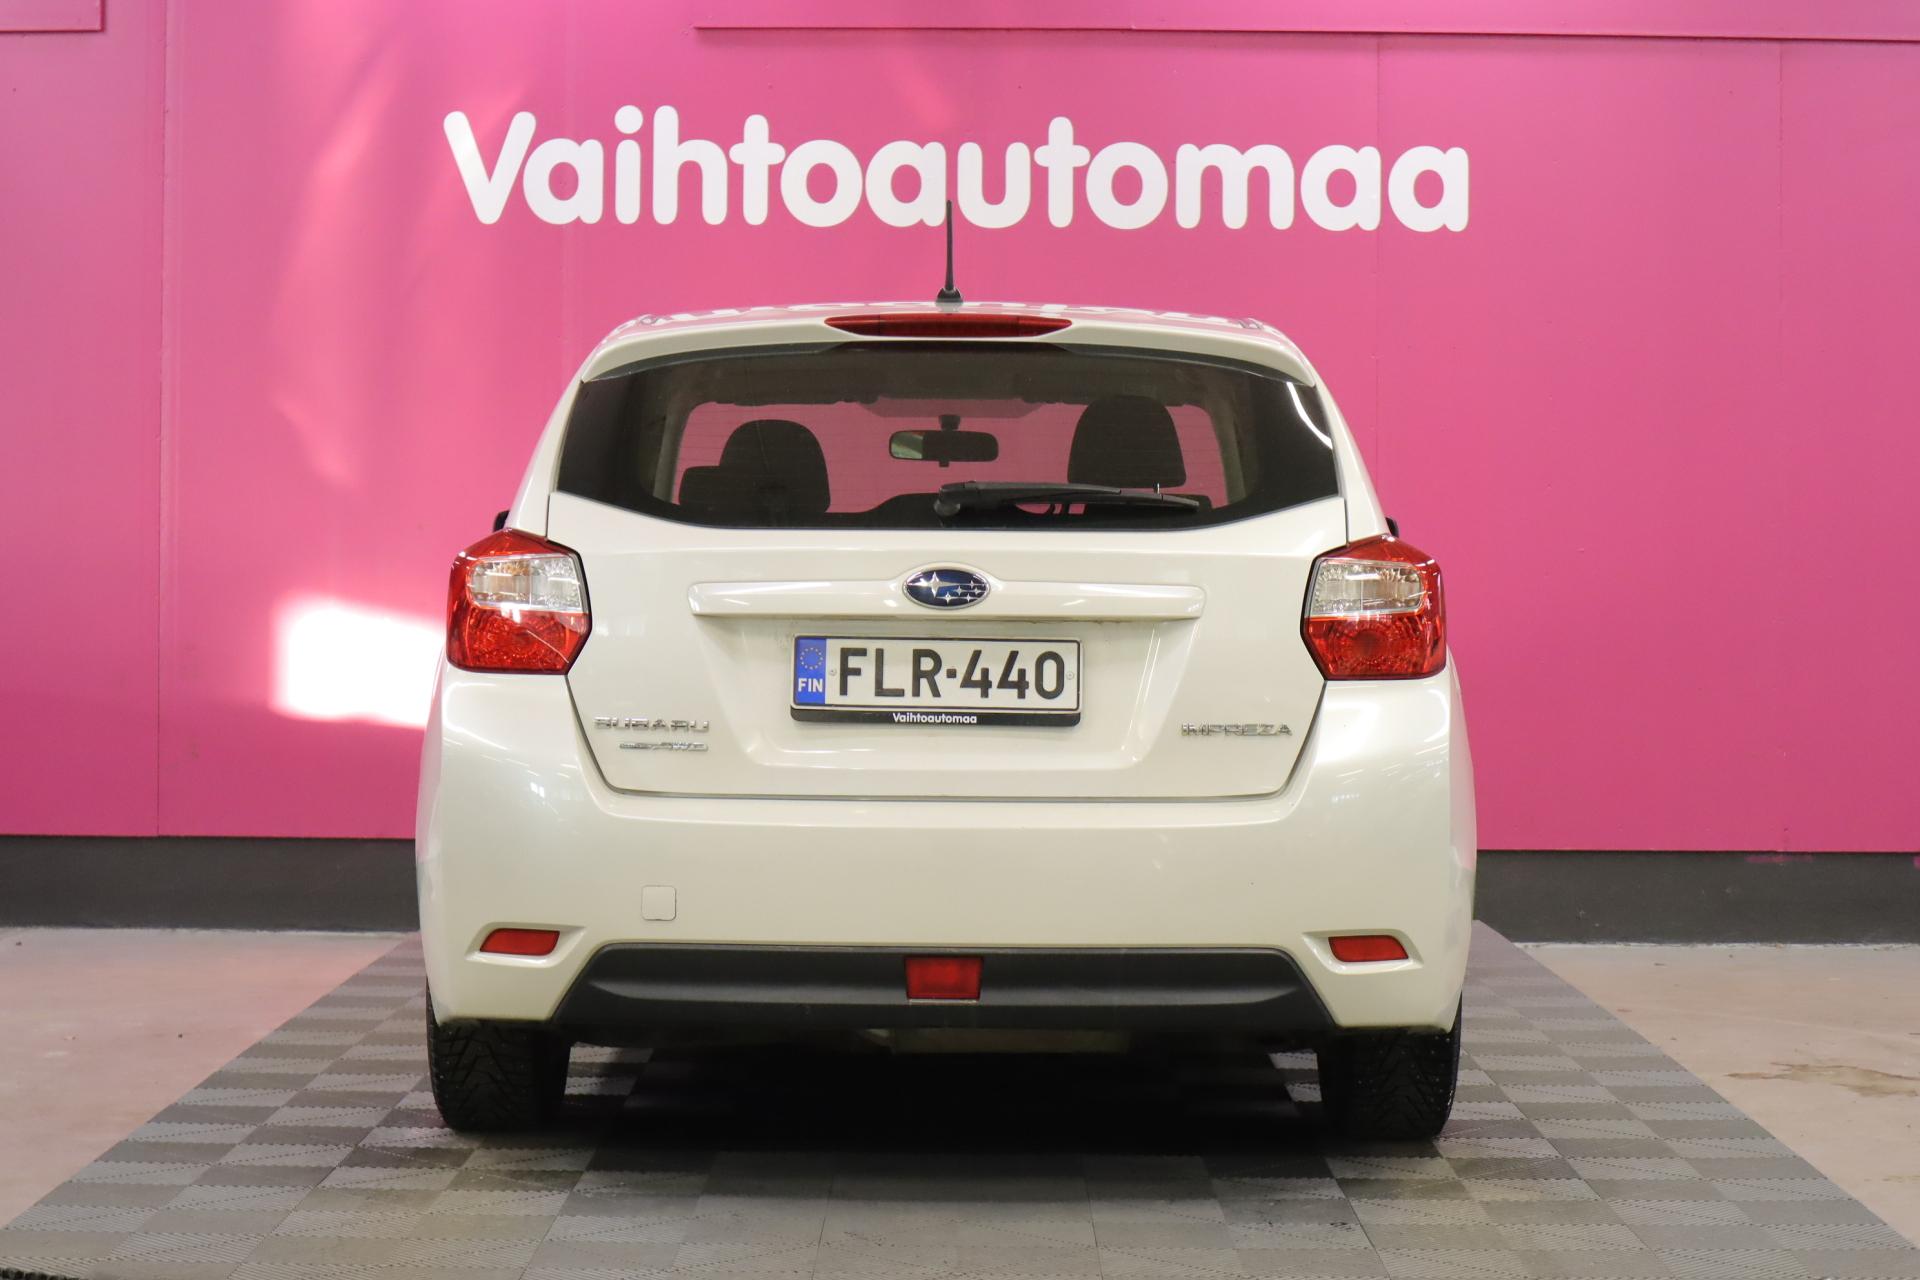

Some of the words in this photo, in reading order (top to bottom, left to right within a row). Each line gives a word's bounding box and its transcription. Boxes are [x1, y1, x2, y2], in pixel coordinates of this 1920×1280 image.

[443, 104, 1470, 233] Vaihtoautomaa
[839, 647, 1065, 700] FLR-440
[798, 678, 824, 693] FIN
[594, 716, 709, 732] SUBARU
[892, 712, 978, 724] Vaihtoautomaa
[1181, 723, 1292, 736] IMPREZA
